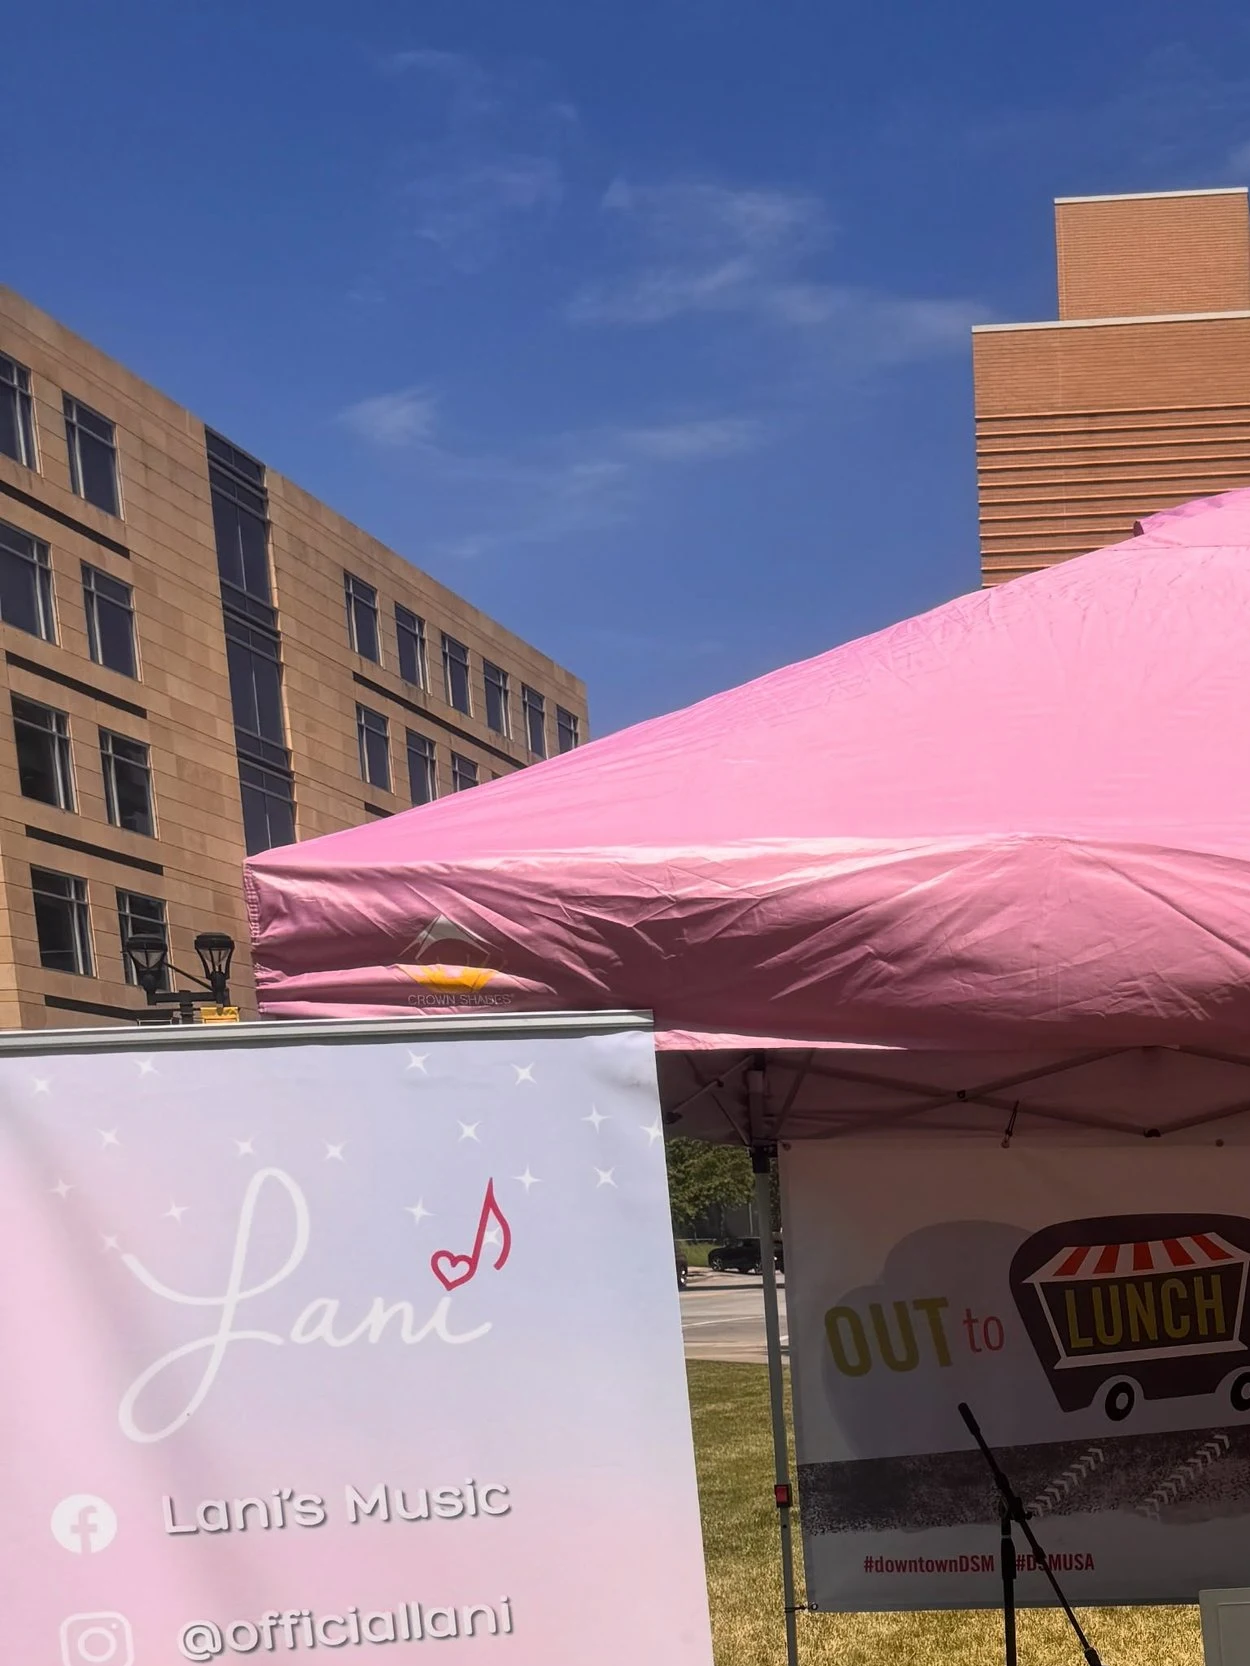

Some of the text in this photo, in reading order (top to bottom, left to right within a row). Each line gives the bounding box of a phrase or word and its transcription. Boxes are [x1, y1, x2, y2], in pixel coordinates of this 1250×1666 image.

[407, 994, 456, 1006] CROWN
[118, 1166, 494, 1444] Lani
[824, 1274, 1228, 1378] OUT to LUNCH
[161, 1477, 514, 1537] Lani's Music
[863, 1553, 1095, 1574] #downtownDSM #DMUSA
[176, 1595, 516, 1664] @officiallani
